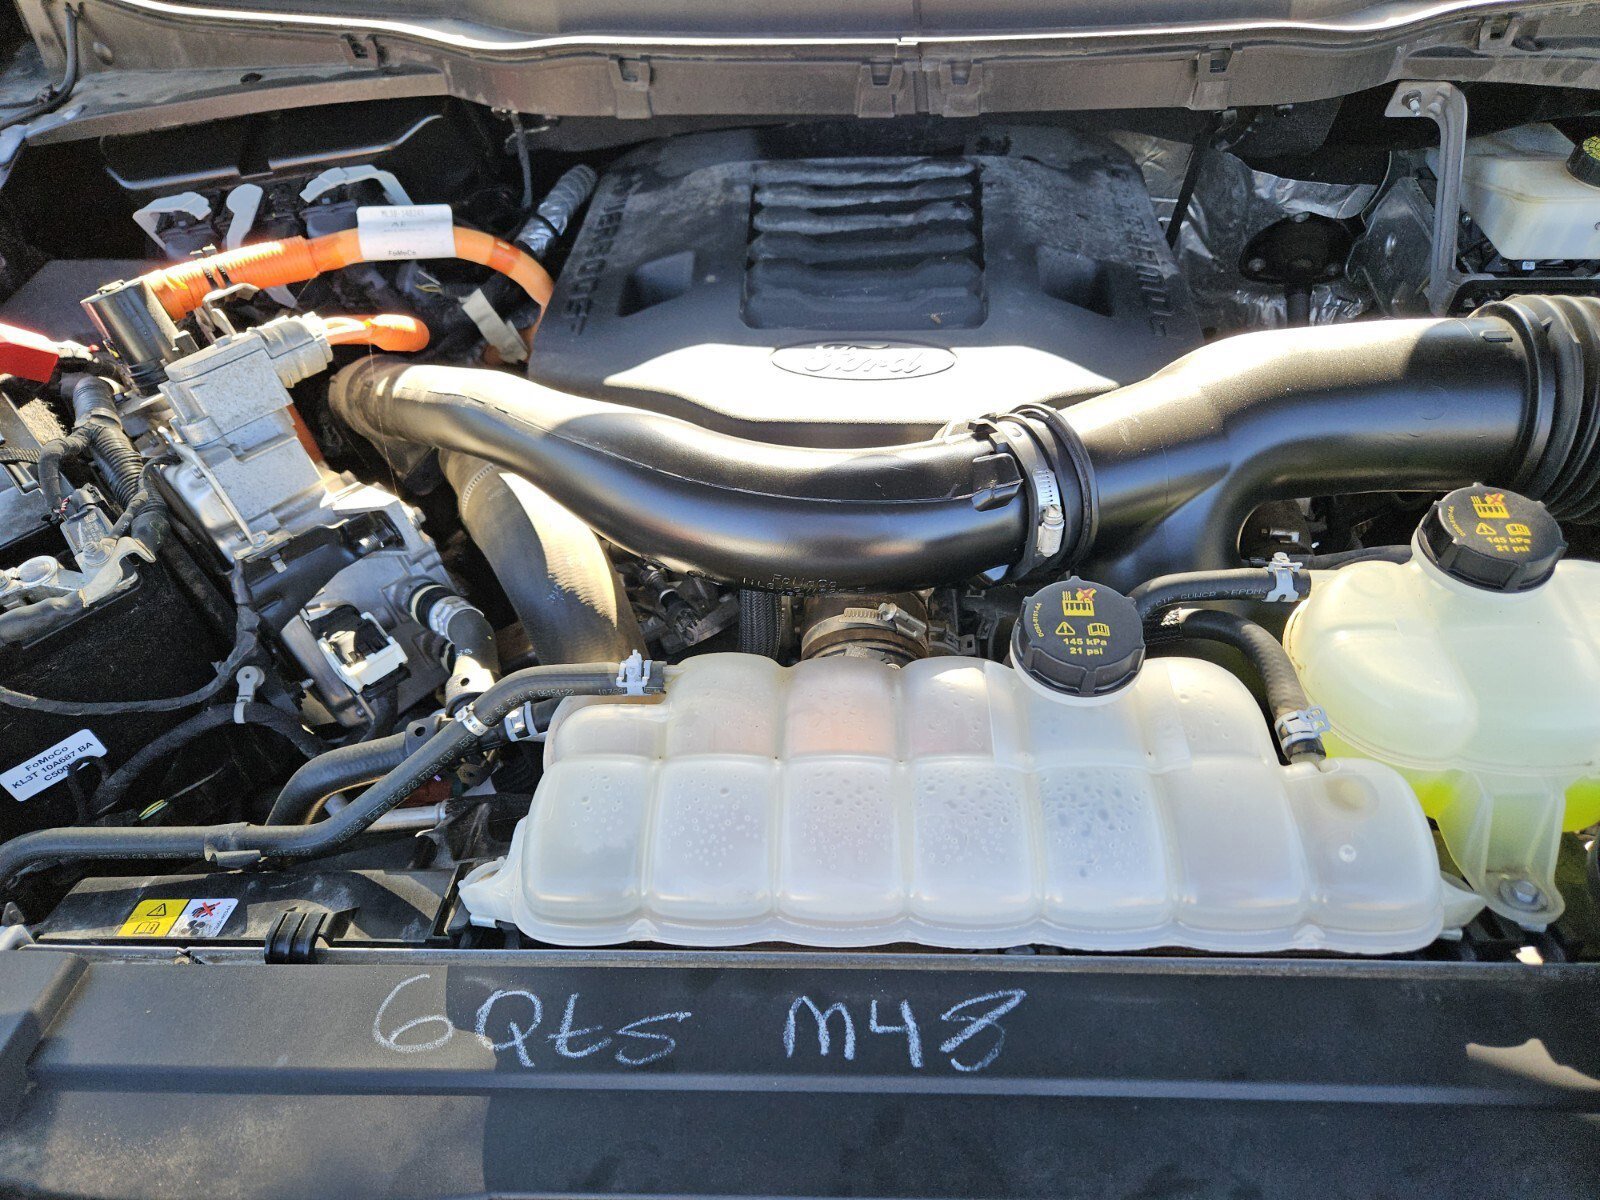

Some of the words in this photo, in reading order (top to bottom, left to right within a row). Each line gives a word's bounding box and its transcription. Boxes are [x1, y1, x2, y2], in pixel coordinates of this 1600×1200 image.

[804, 343, 925, 374] Ford
[1512, 545, 1531, 553] psi
[1063, 638, 1083, 646] 145
[1086, 638, 1108, 646] kPa
[1069, 647, 1083, 655] 21
[1086, 647, 1104, 656] psi
[12, 771, 39, 789] KL3T
[41, 750, 76, 773] 10A687
[77, 742, 94, 753] BA
[25, 746, 69, 772] FoMoCo
[43, 762, 74, 782] C500
[372, 973, 454, 1053] 6
